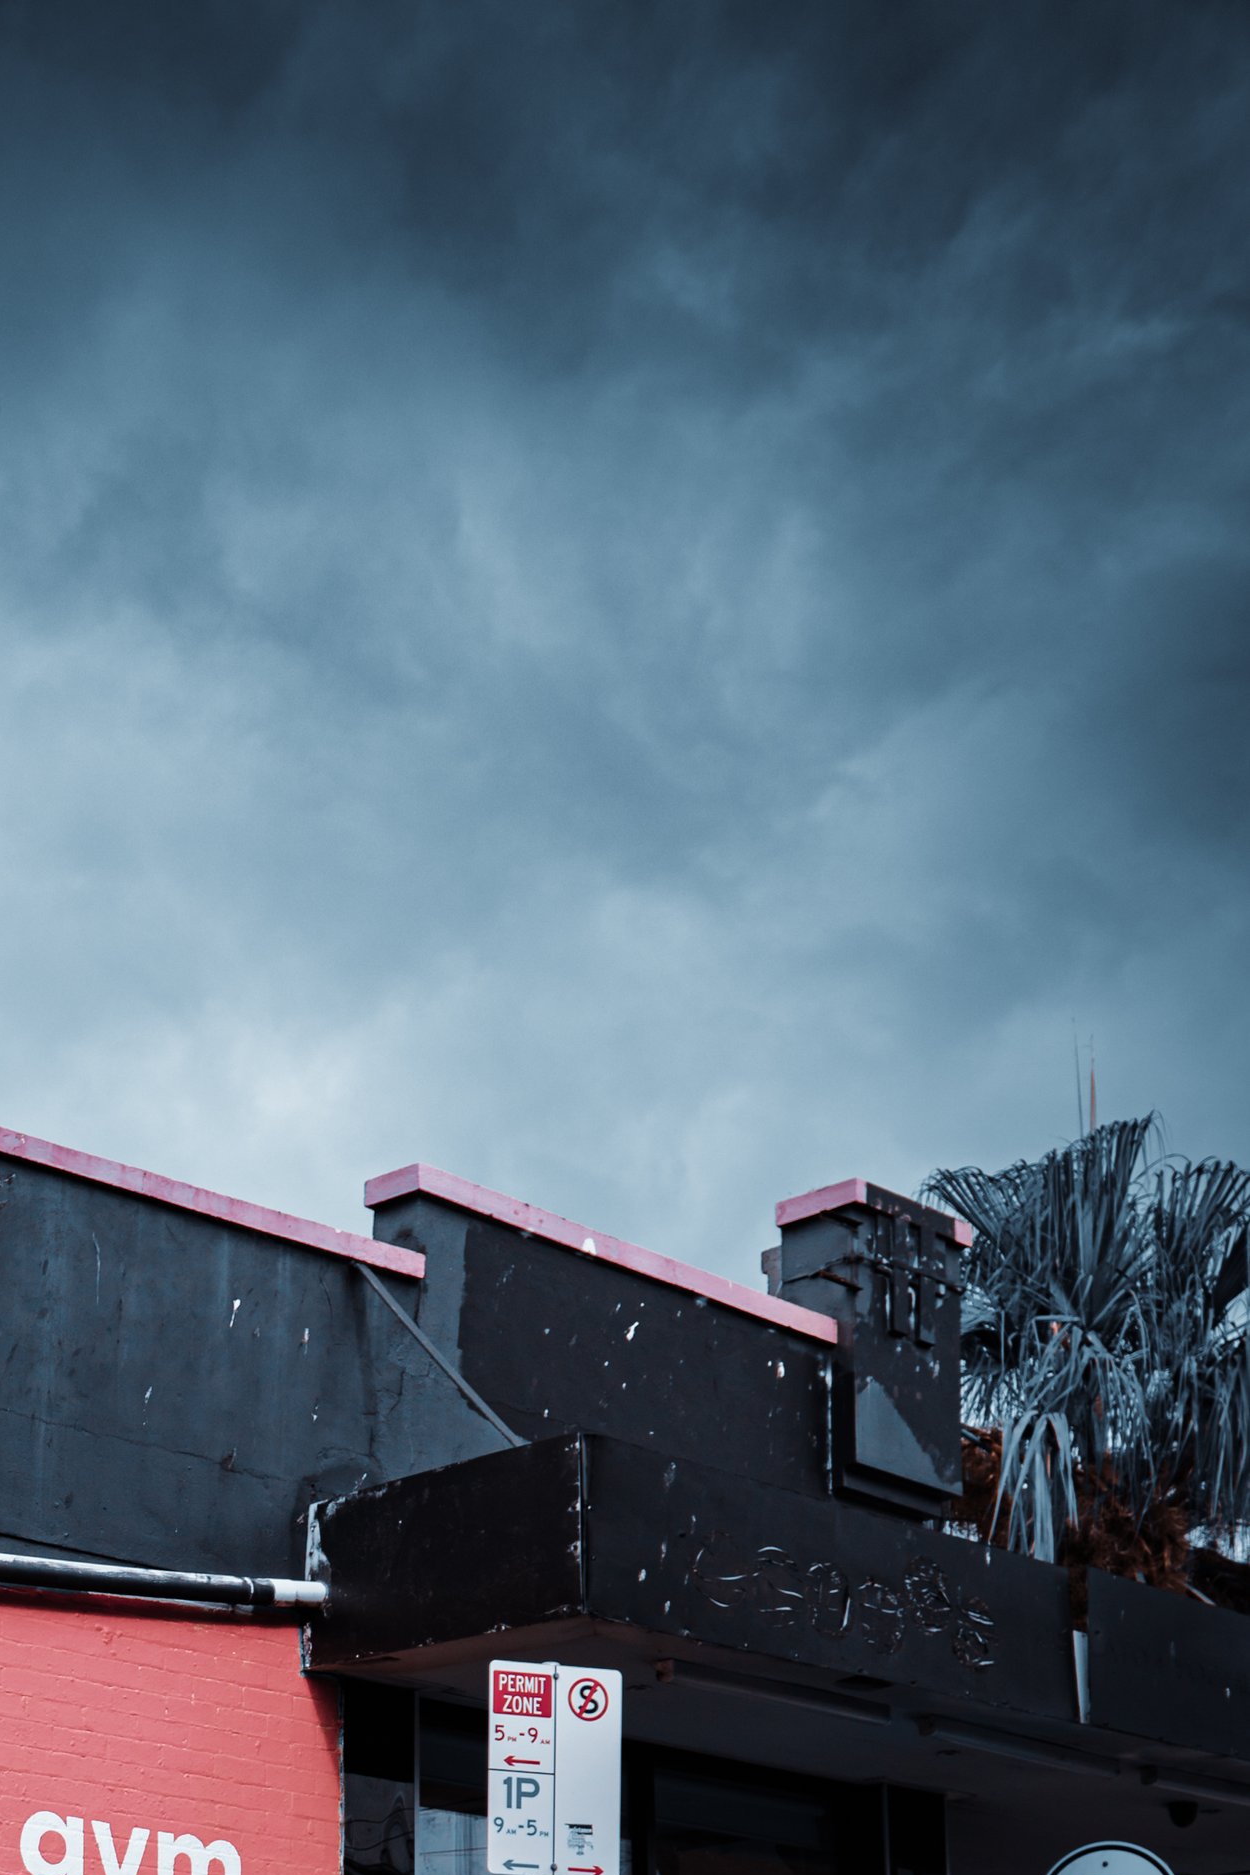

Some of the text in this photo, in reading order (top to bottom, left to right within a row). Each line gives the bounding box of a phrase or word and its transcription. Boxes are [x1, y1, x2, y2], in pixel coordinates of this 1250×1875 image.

[498, 1673, 547, 1695] PERMIT
[502, 1694, 543, 1715] ZONE
[503, 1776, 540, 1809] 1P
